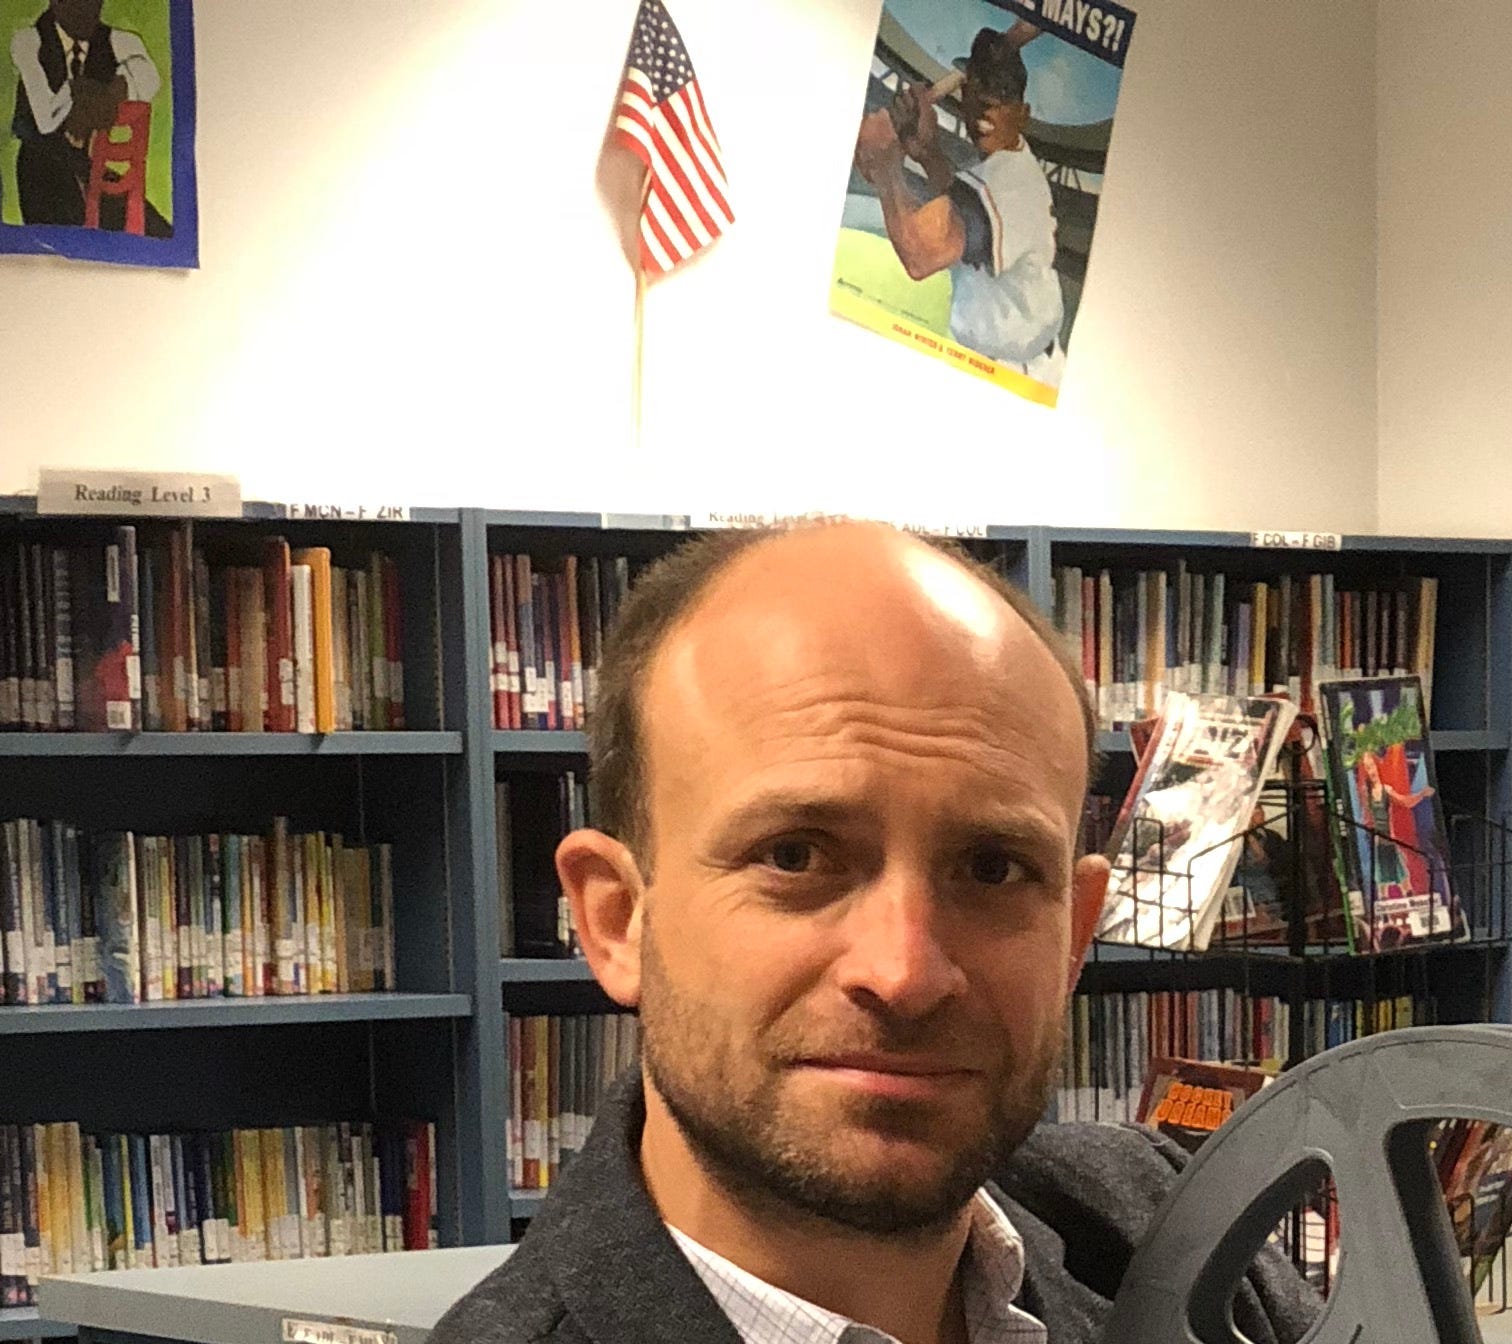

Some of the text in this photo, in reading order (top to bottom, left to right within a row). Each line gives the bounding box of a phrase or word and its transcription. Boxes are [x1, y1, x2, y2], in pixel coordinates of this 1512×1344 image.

[1041, 0, 1125, 52] MAYS?!
[74, 484, 211, 506] Reading Level 3
